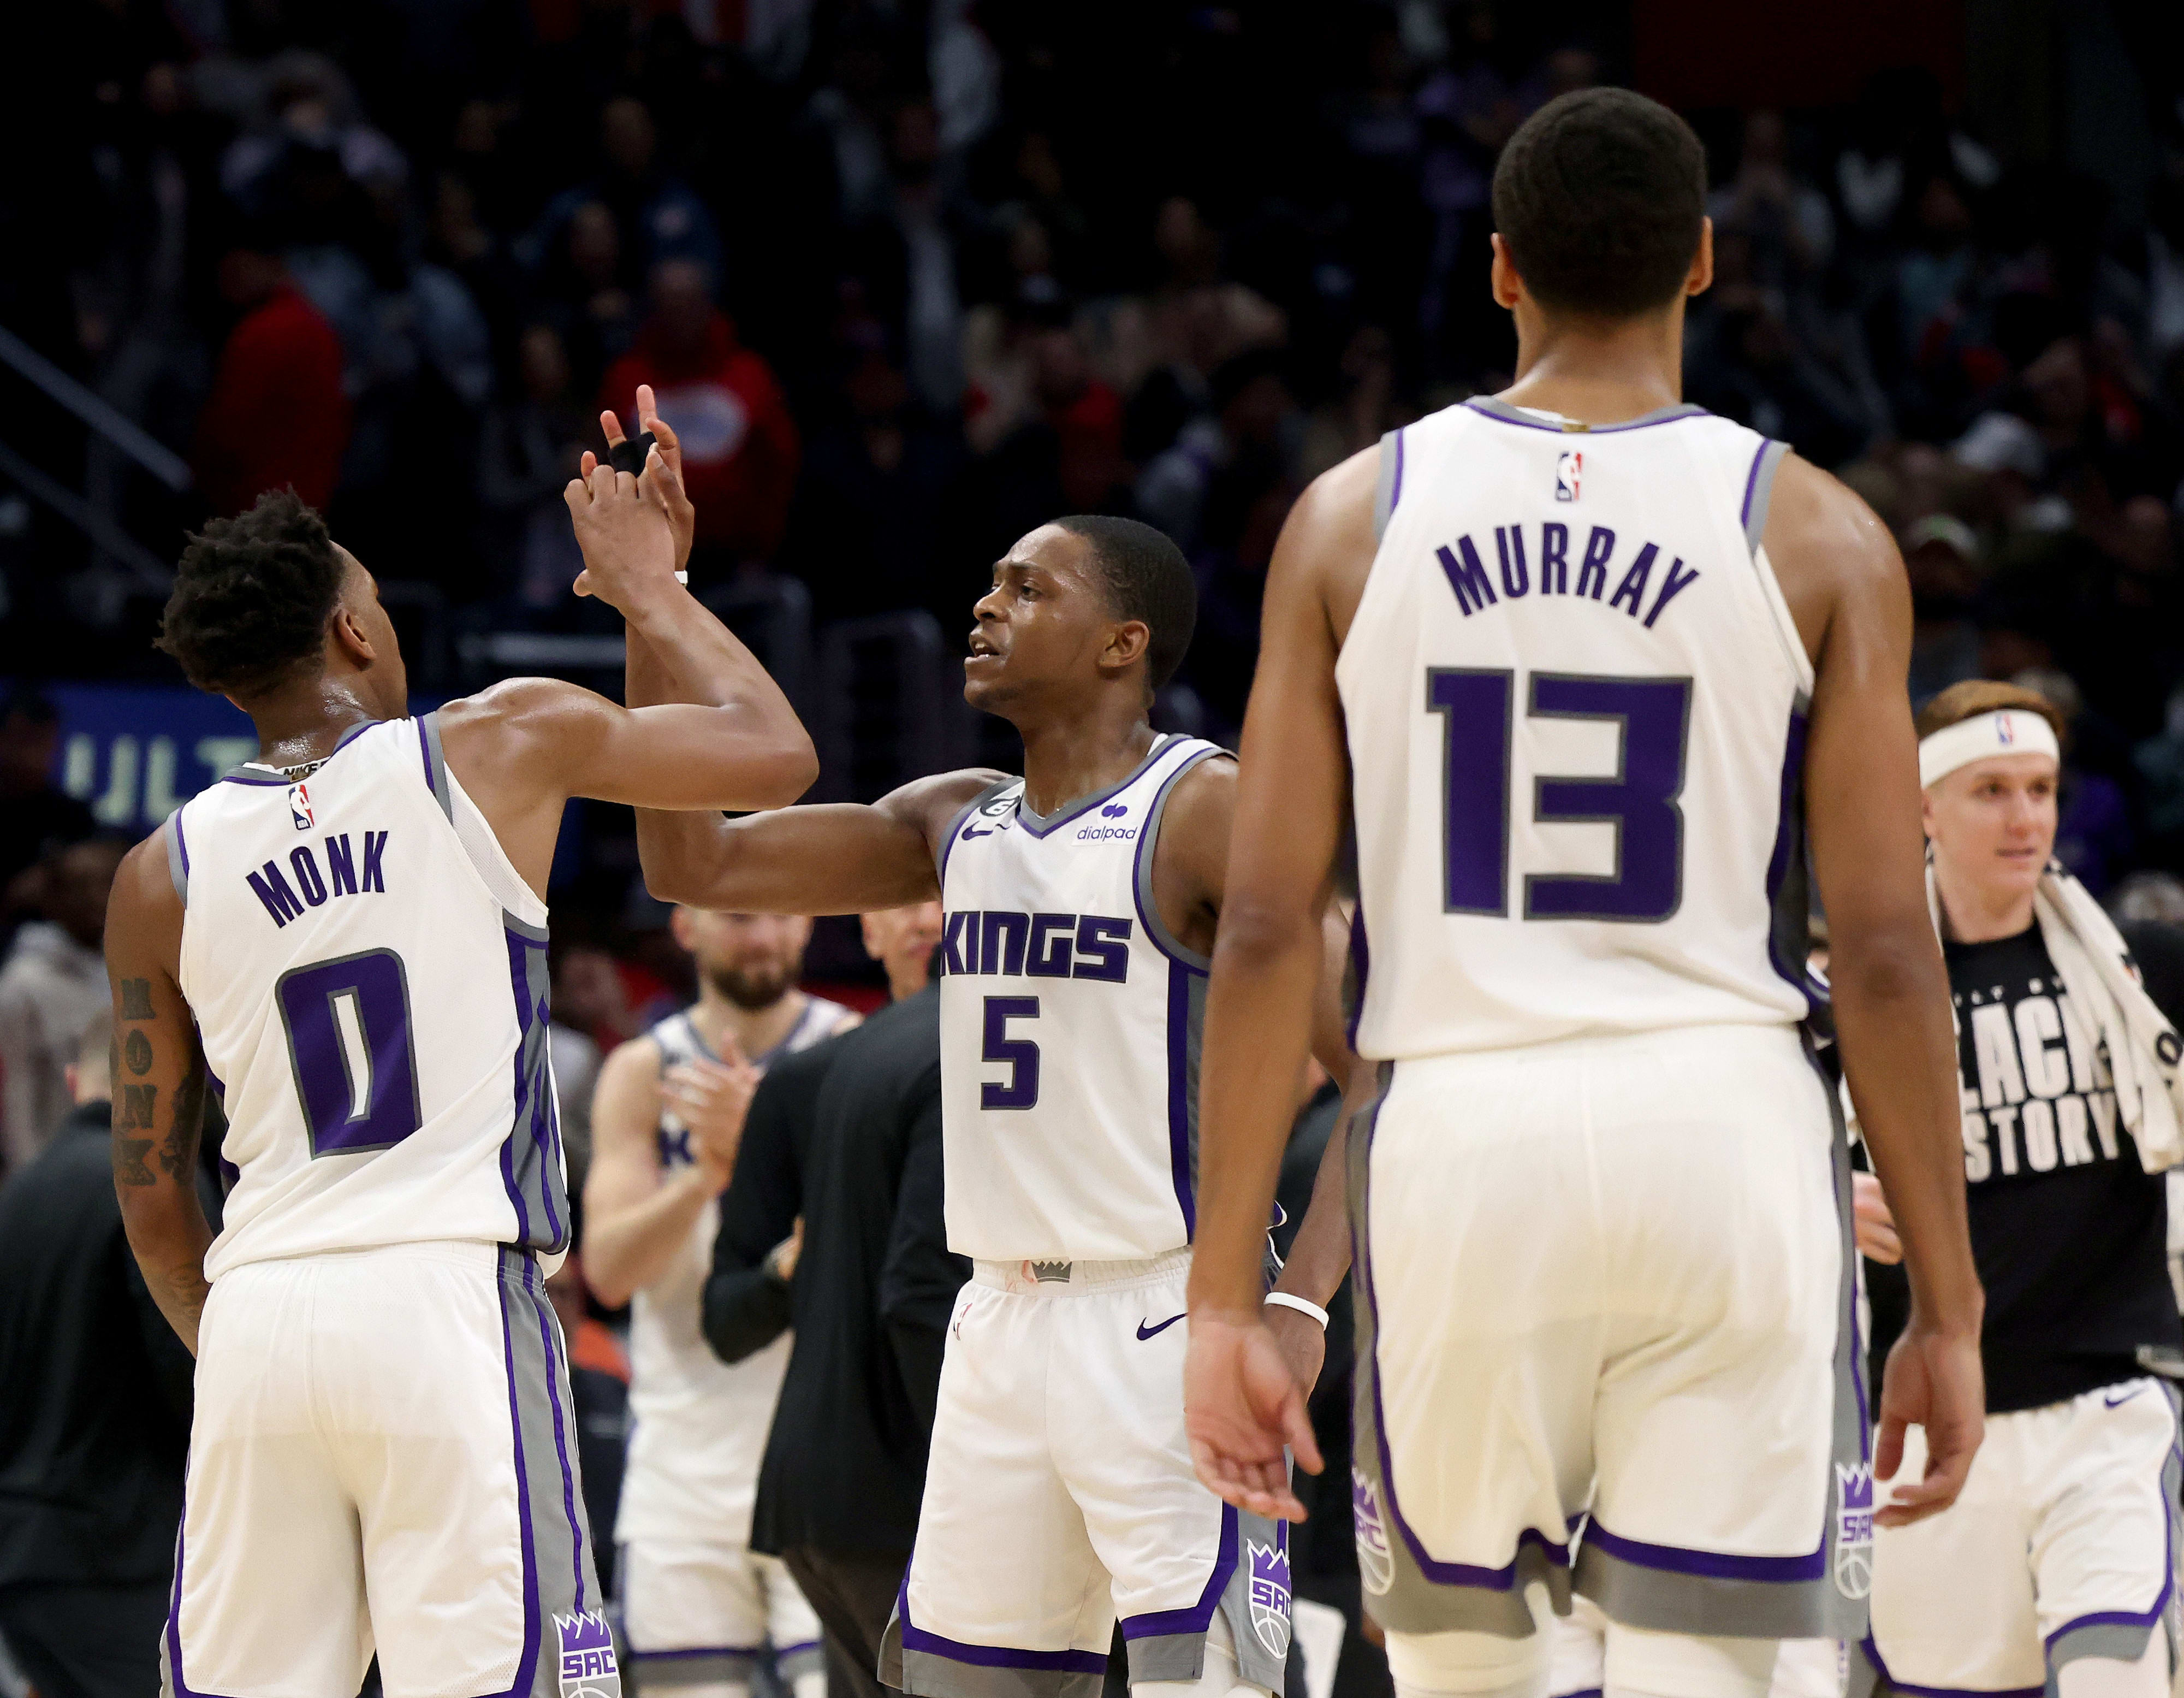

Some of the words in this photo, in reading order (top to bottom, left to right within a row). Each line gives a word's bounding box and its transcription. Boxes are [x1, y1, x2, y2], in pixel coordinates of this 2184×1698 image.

[1435, 522, 1699, 629] MURRAY
[1077, 825, 1138, 842] dialpad
[1426, 666, 1694, 924] 13
[246, 831, 388, 928] MONK
[940, 911, 1132, 984] KINGS
[275, 947, 422, 1161] 0
[980, 996, 1040, 1110] 5
[1965, 995, 2114, 1112] ACK
[1842, 1514, 1873, 1542] SA
[563, 1649, 616, 1679] SAC
